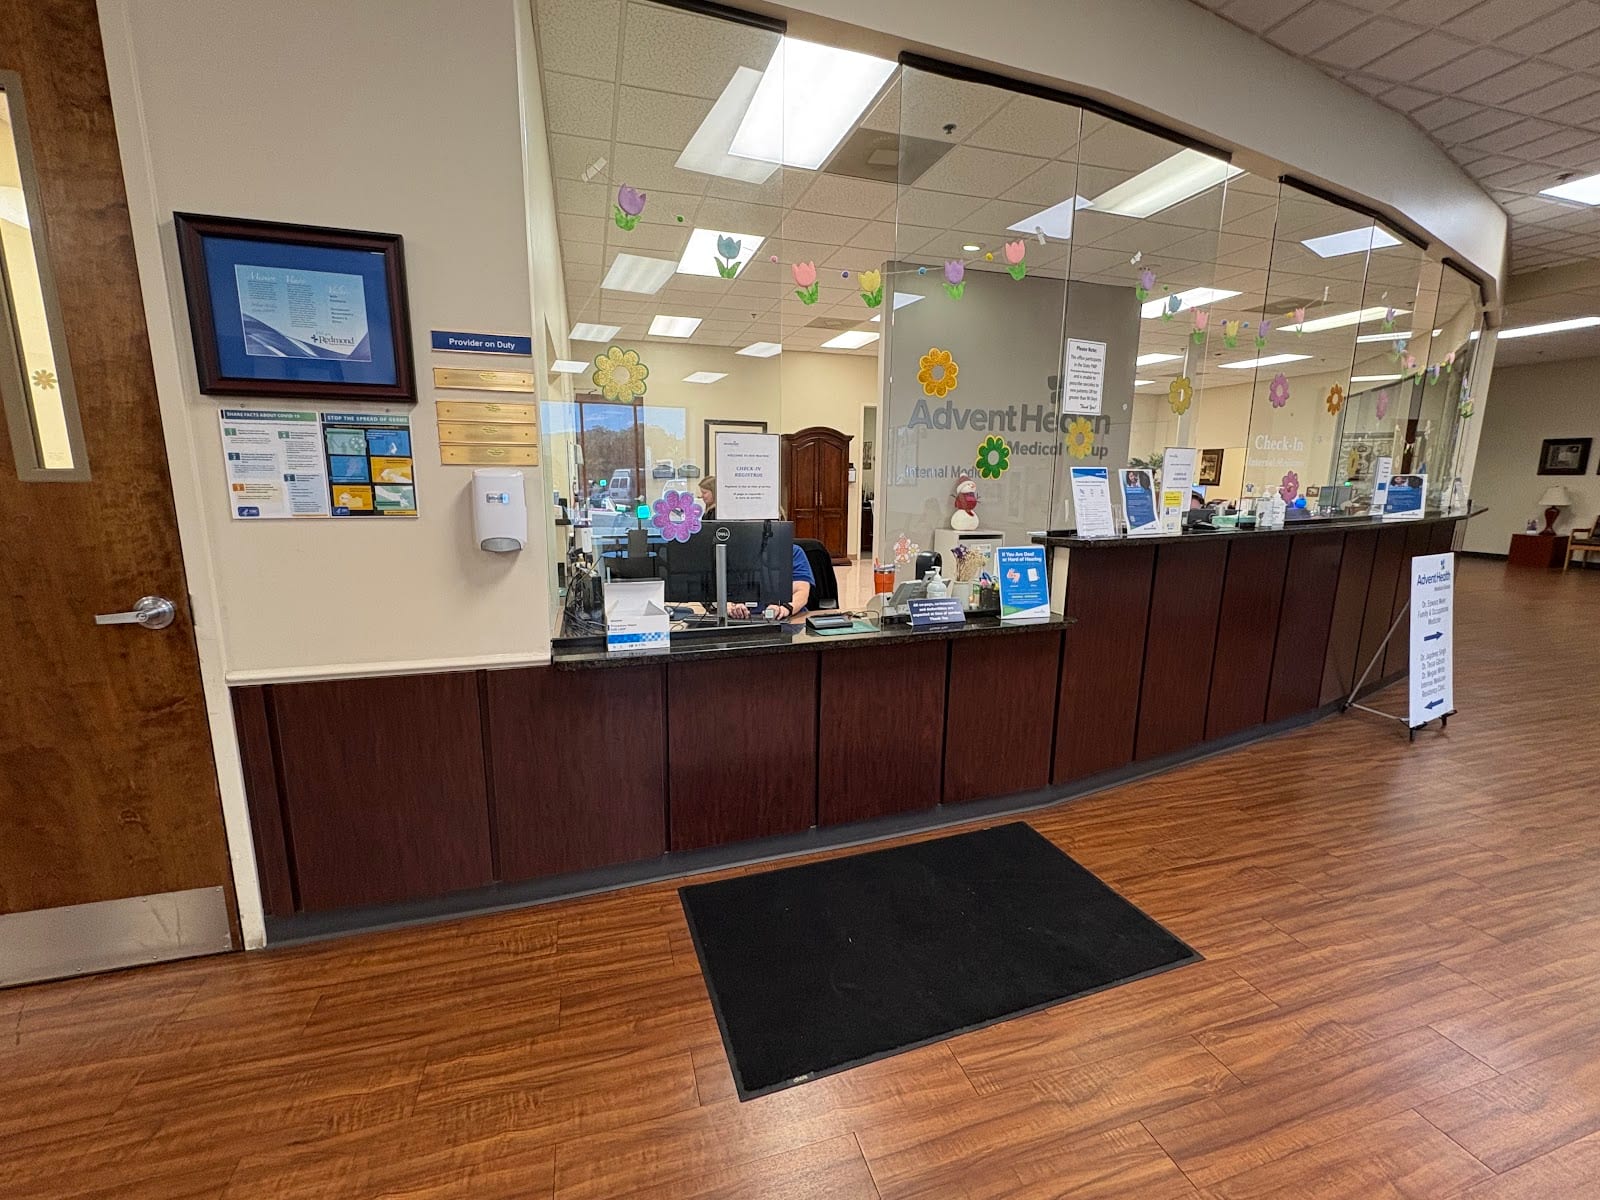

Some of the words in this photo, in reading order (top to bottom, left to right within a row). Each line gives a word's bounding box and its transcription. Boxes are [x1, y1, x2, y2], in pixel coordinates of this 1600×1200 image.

[319, 335, 355, 344] Redmond
[448, 337, 484, 347] Provider
[496, 341, 516, 351] Duty
[1255, 434, 1304, 452] Check-In
[904, 463, 948, 479] Internal
[1416, 571, 1451, 586] AdventHealth
